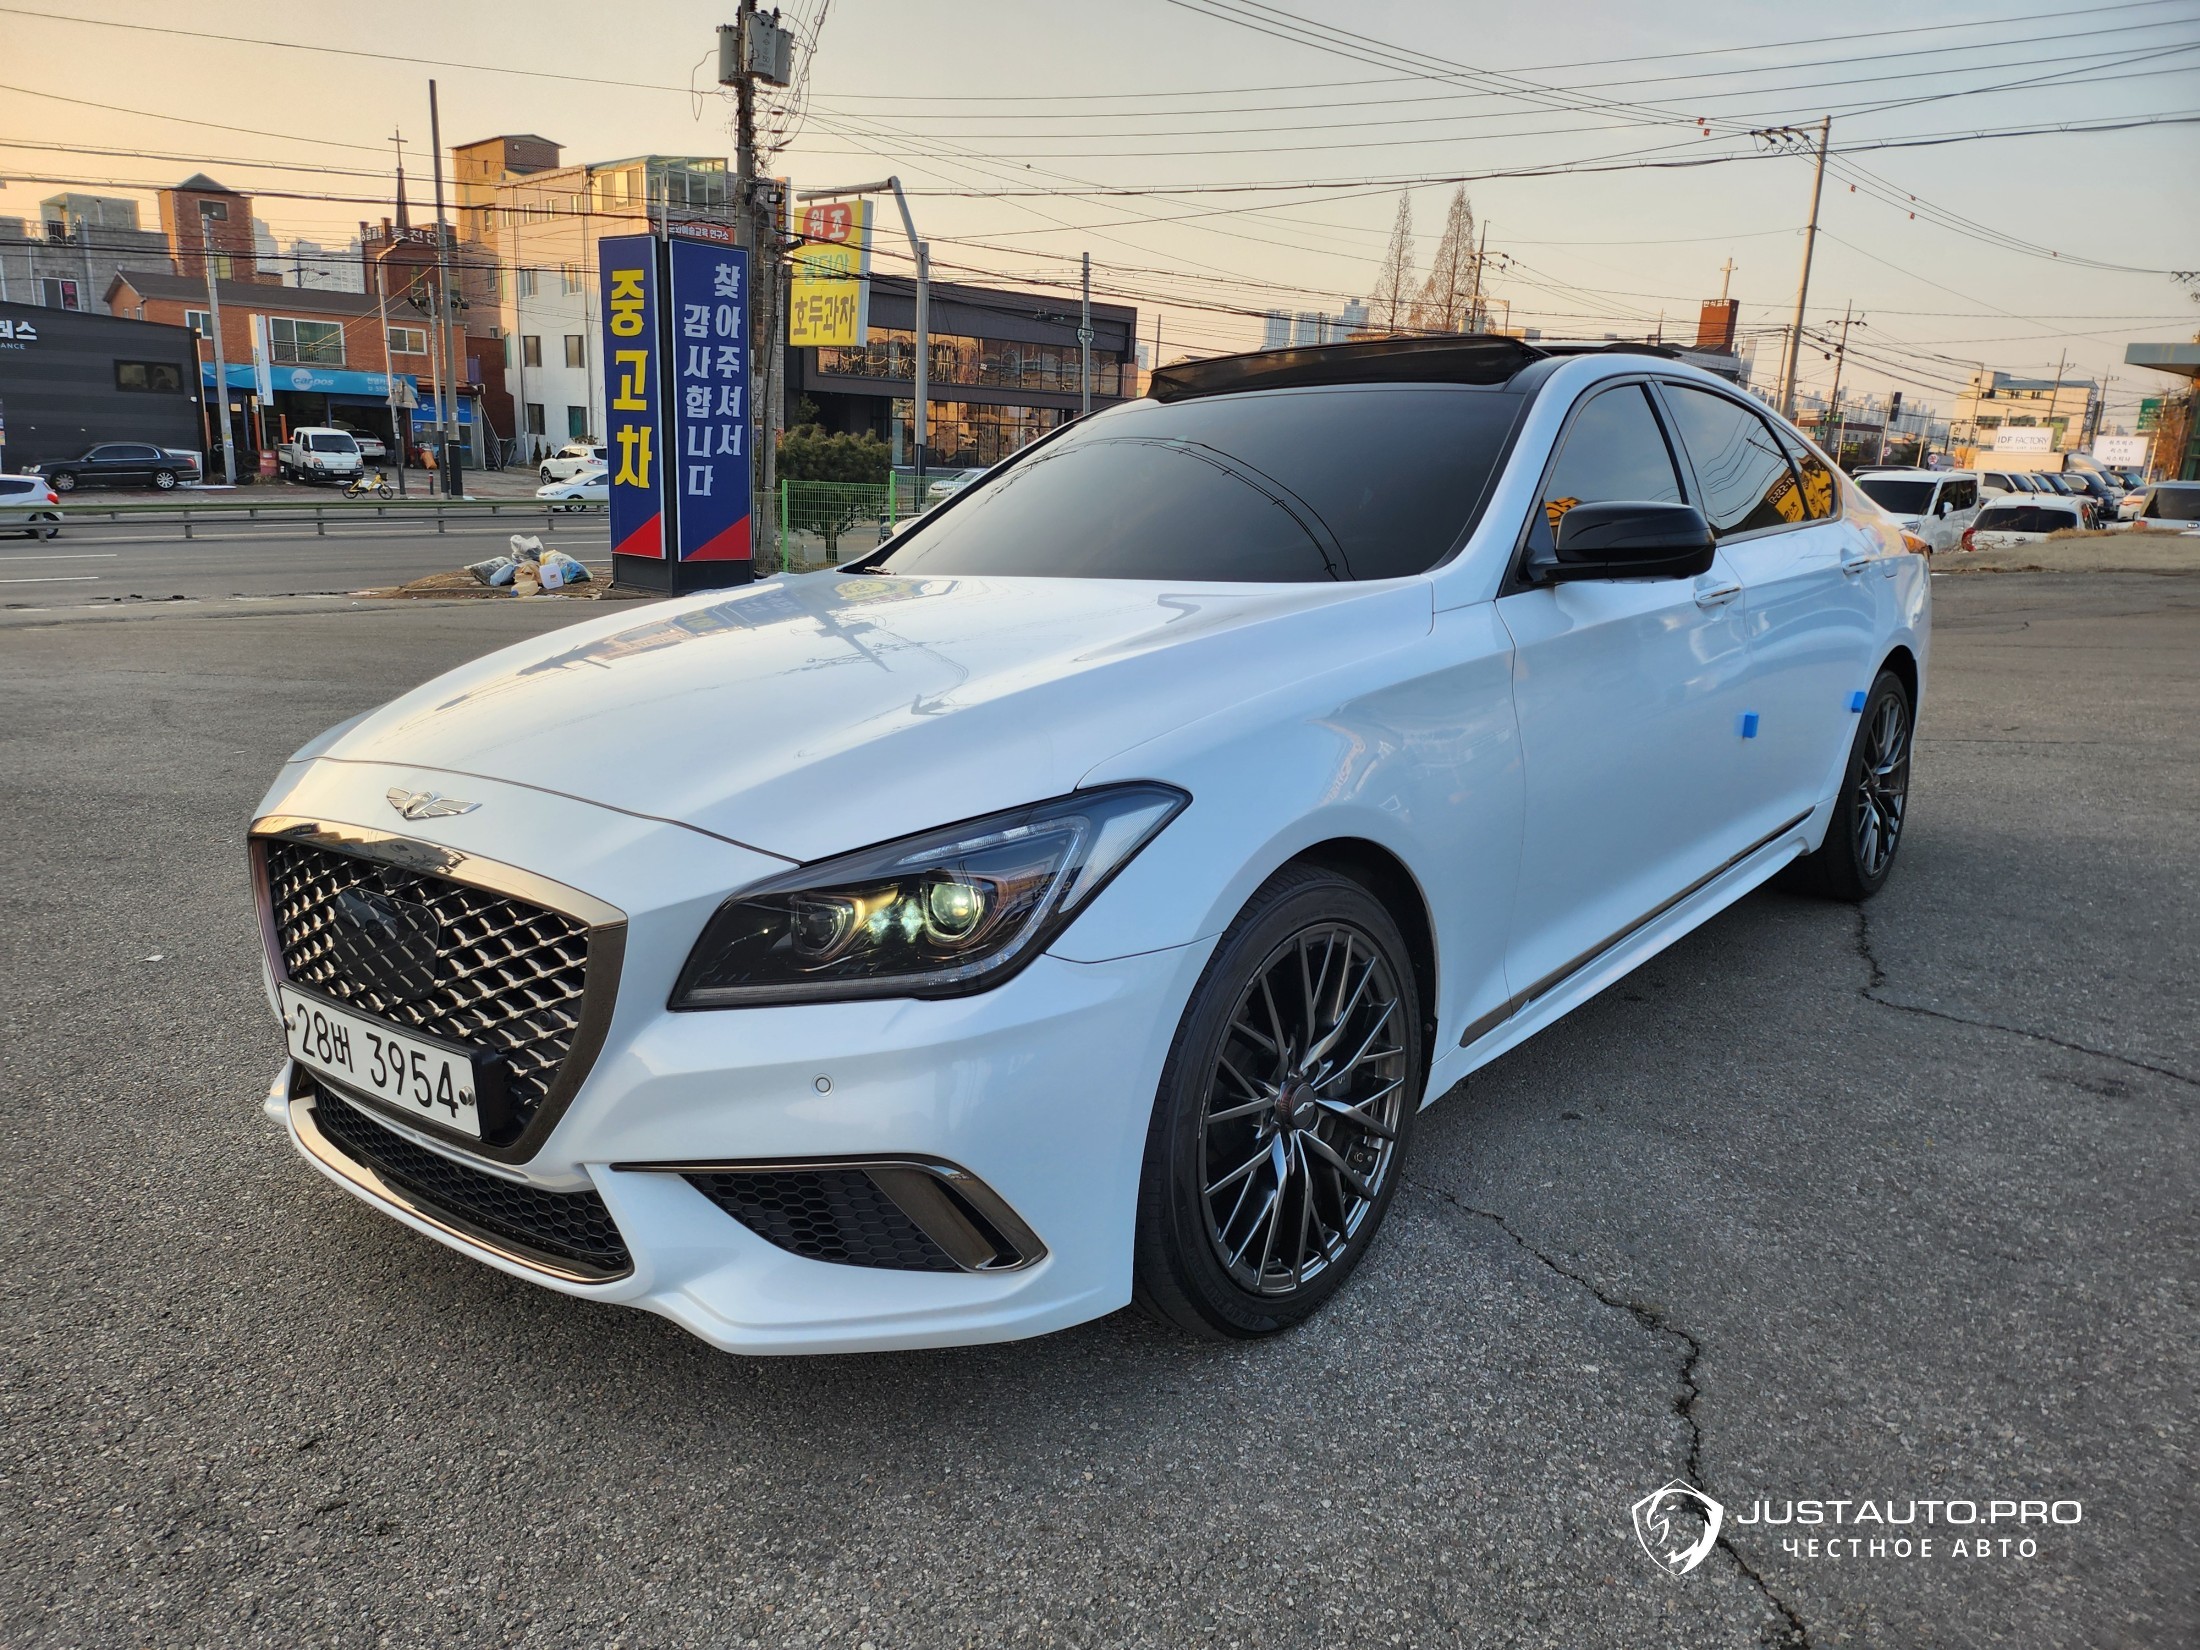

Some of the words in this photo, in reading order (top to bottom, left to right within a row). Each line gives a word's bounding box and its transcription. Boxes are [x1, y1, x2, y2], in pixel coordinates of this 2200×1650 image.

[709, 229, 729, 240] 연구소
[810, 208, 845, 243] 원조
[793, 294, 855, 340] 호두과자
[293, 376, 334, 387] carpos
[610, 269, 652, 489] 중고차
[714, 263, 742, 456] 찾아주셔서
[684, 304, 714, 497] 감사합니다
[1997, 436, 2013, 444] IDF
[2015, 436, 2048, 445] FACTORY
[297, 1002, 354, 1074] 28버
[366, 1031, 460, 1119] 3954
